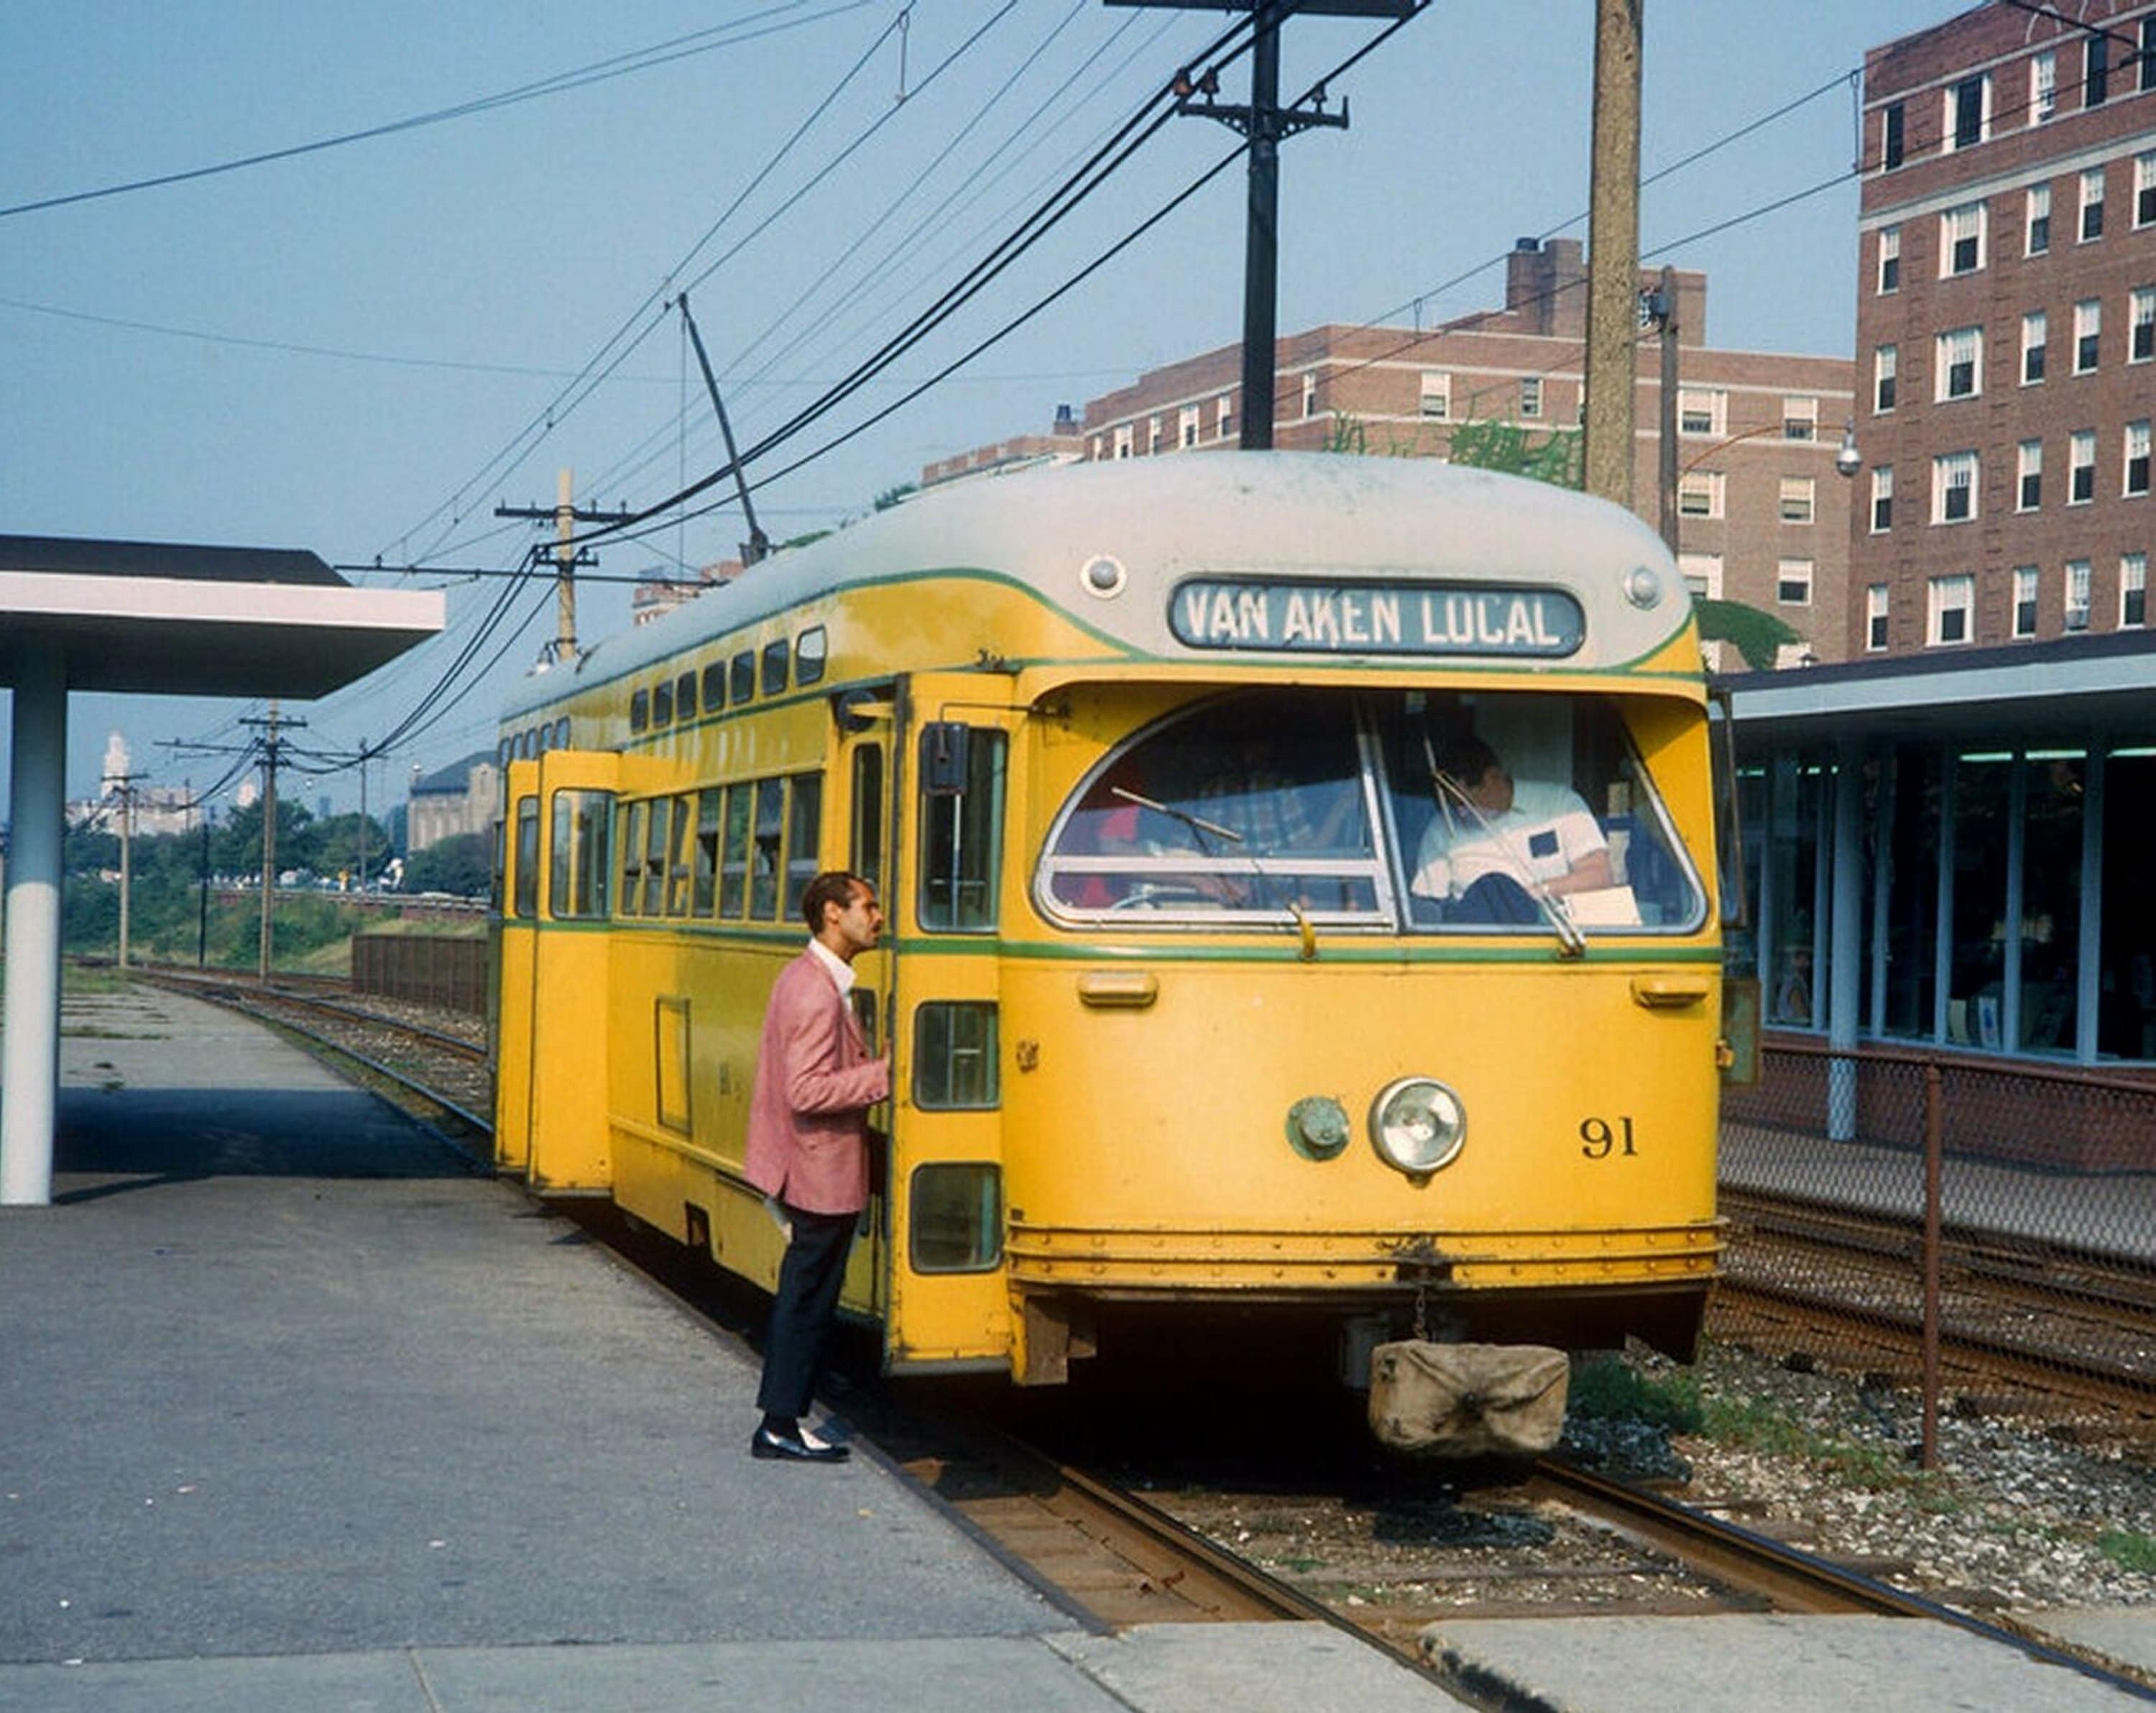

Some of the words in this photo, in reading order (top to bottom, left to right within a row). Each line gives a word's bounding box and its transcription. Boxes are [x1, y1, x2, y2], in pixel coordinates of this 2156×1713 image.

[1187, 590, 1269, 639] VAN
[1283, 591, 1401, 648] AKEN
[1421, 592, 1560, 646] LOCAL
[1579, 1116, 1639, 1159] 91
